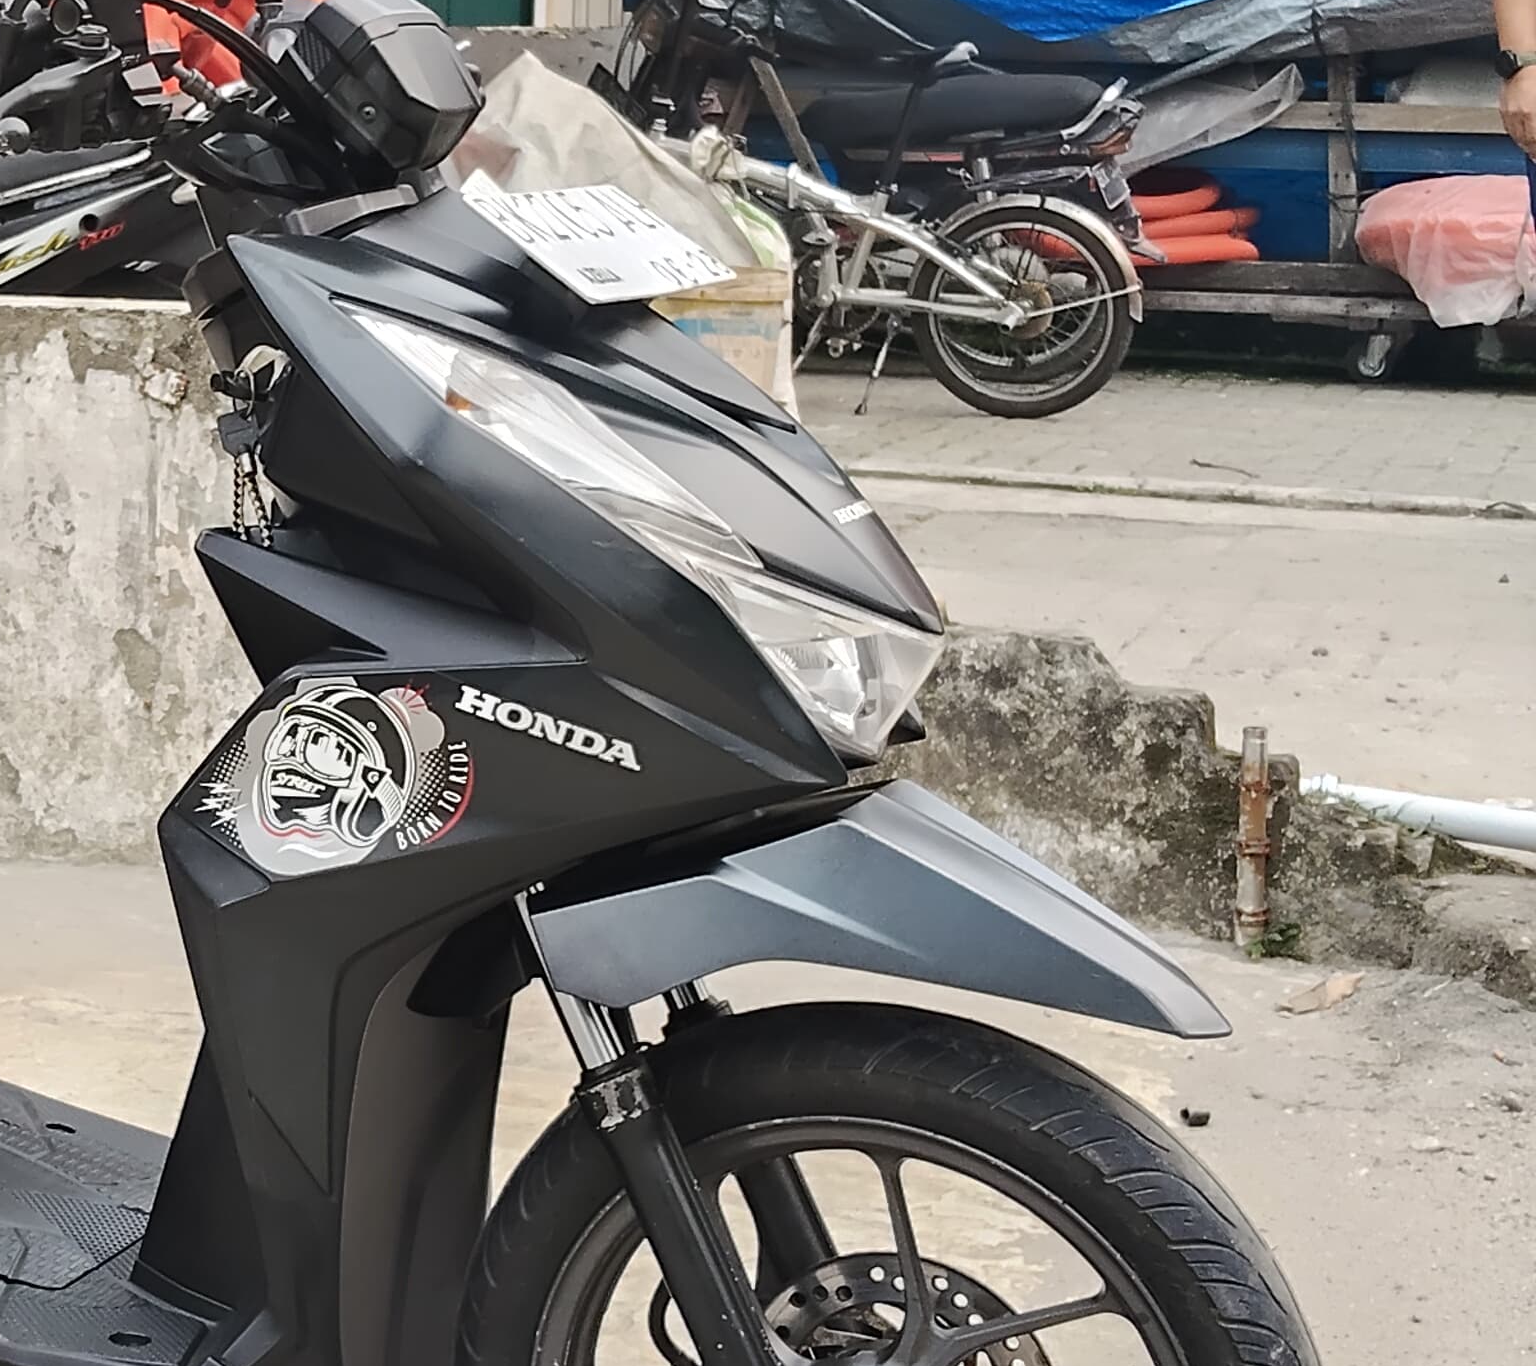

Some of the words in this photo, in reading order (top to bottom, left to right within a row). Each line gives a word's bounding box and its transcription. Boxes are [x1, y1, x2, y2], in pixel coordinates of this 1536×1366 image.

[453, 684, 642, 773] HONDA
[395, 811, 444, 851] BORN
[436, 789, 463, 813] TO
